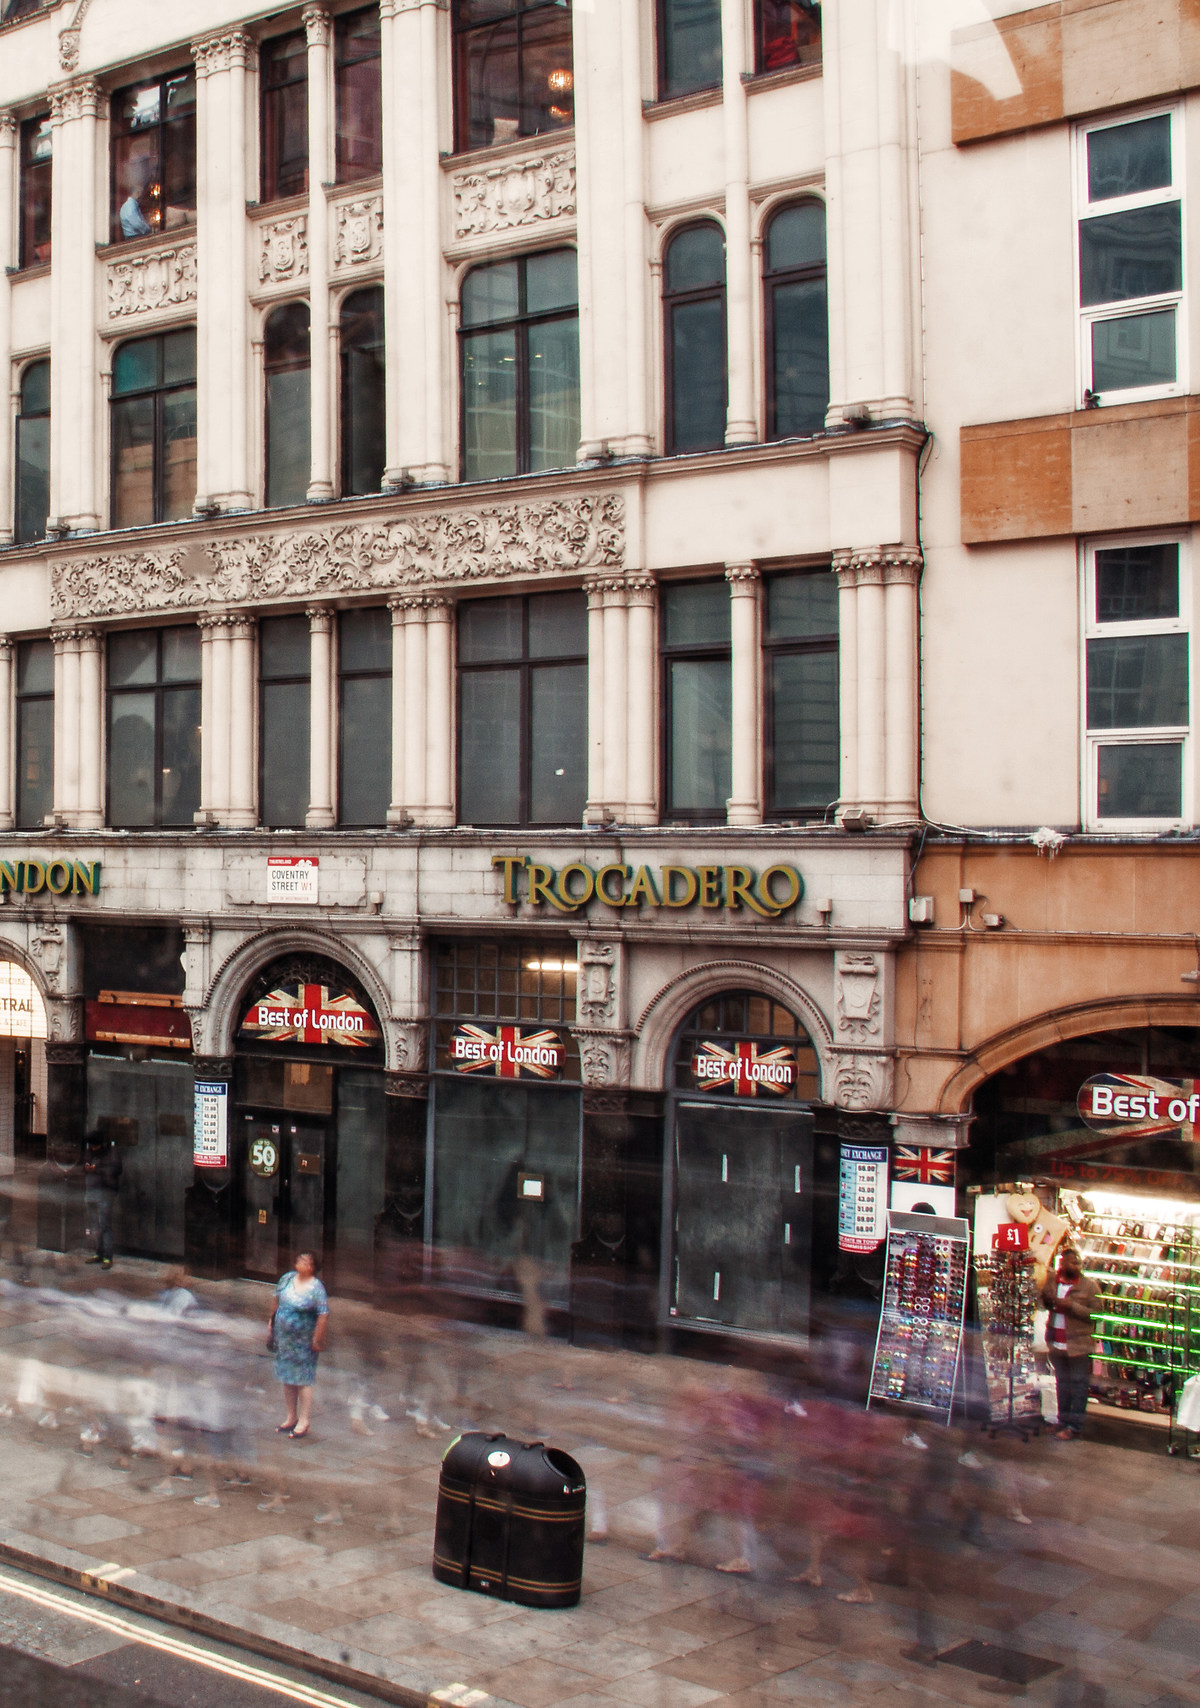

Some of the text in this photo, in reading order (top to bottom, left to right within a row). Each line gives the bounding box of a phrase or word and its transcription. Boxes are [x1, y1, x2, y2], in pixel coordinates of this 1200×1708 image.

[271, 870, 309, 880] COVENTRY
[271, 881, 312, 891] STREET W1
[491, 855, 804, 918] TROCADERO
[258, 1006, 363, 1031] Best of London
[455, 1037, 558, 1066] Best of London
[697, 1055, 792, 1084] Best of London
[1092, 1086, 1200, 1123] Best of
[252, 1145, 276, 1167] 50
[851, 1150, 882, 1160] EXCHANGE
[1051, 1160, 1075, 1179] Up
[1079, 1163, 1097, 1179] to
[1102, 1166, 1141, 1184] 75%
[1006, 1228, 1021, 1246] £1
